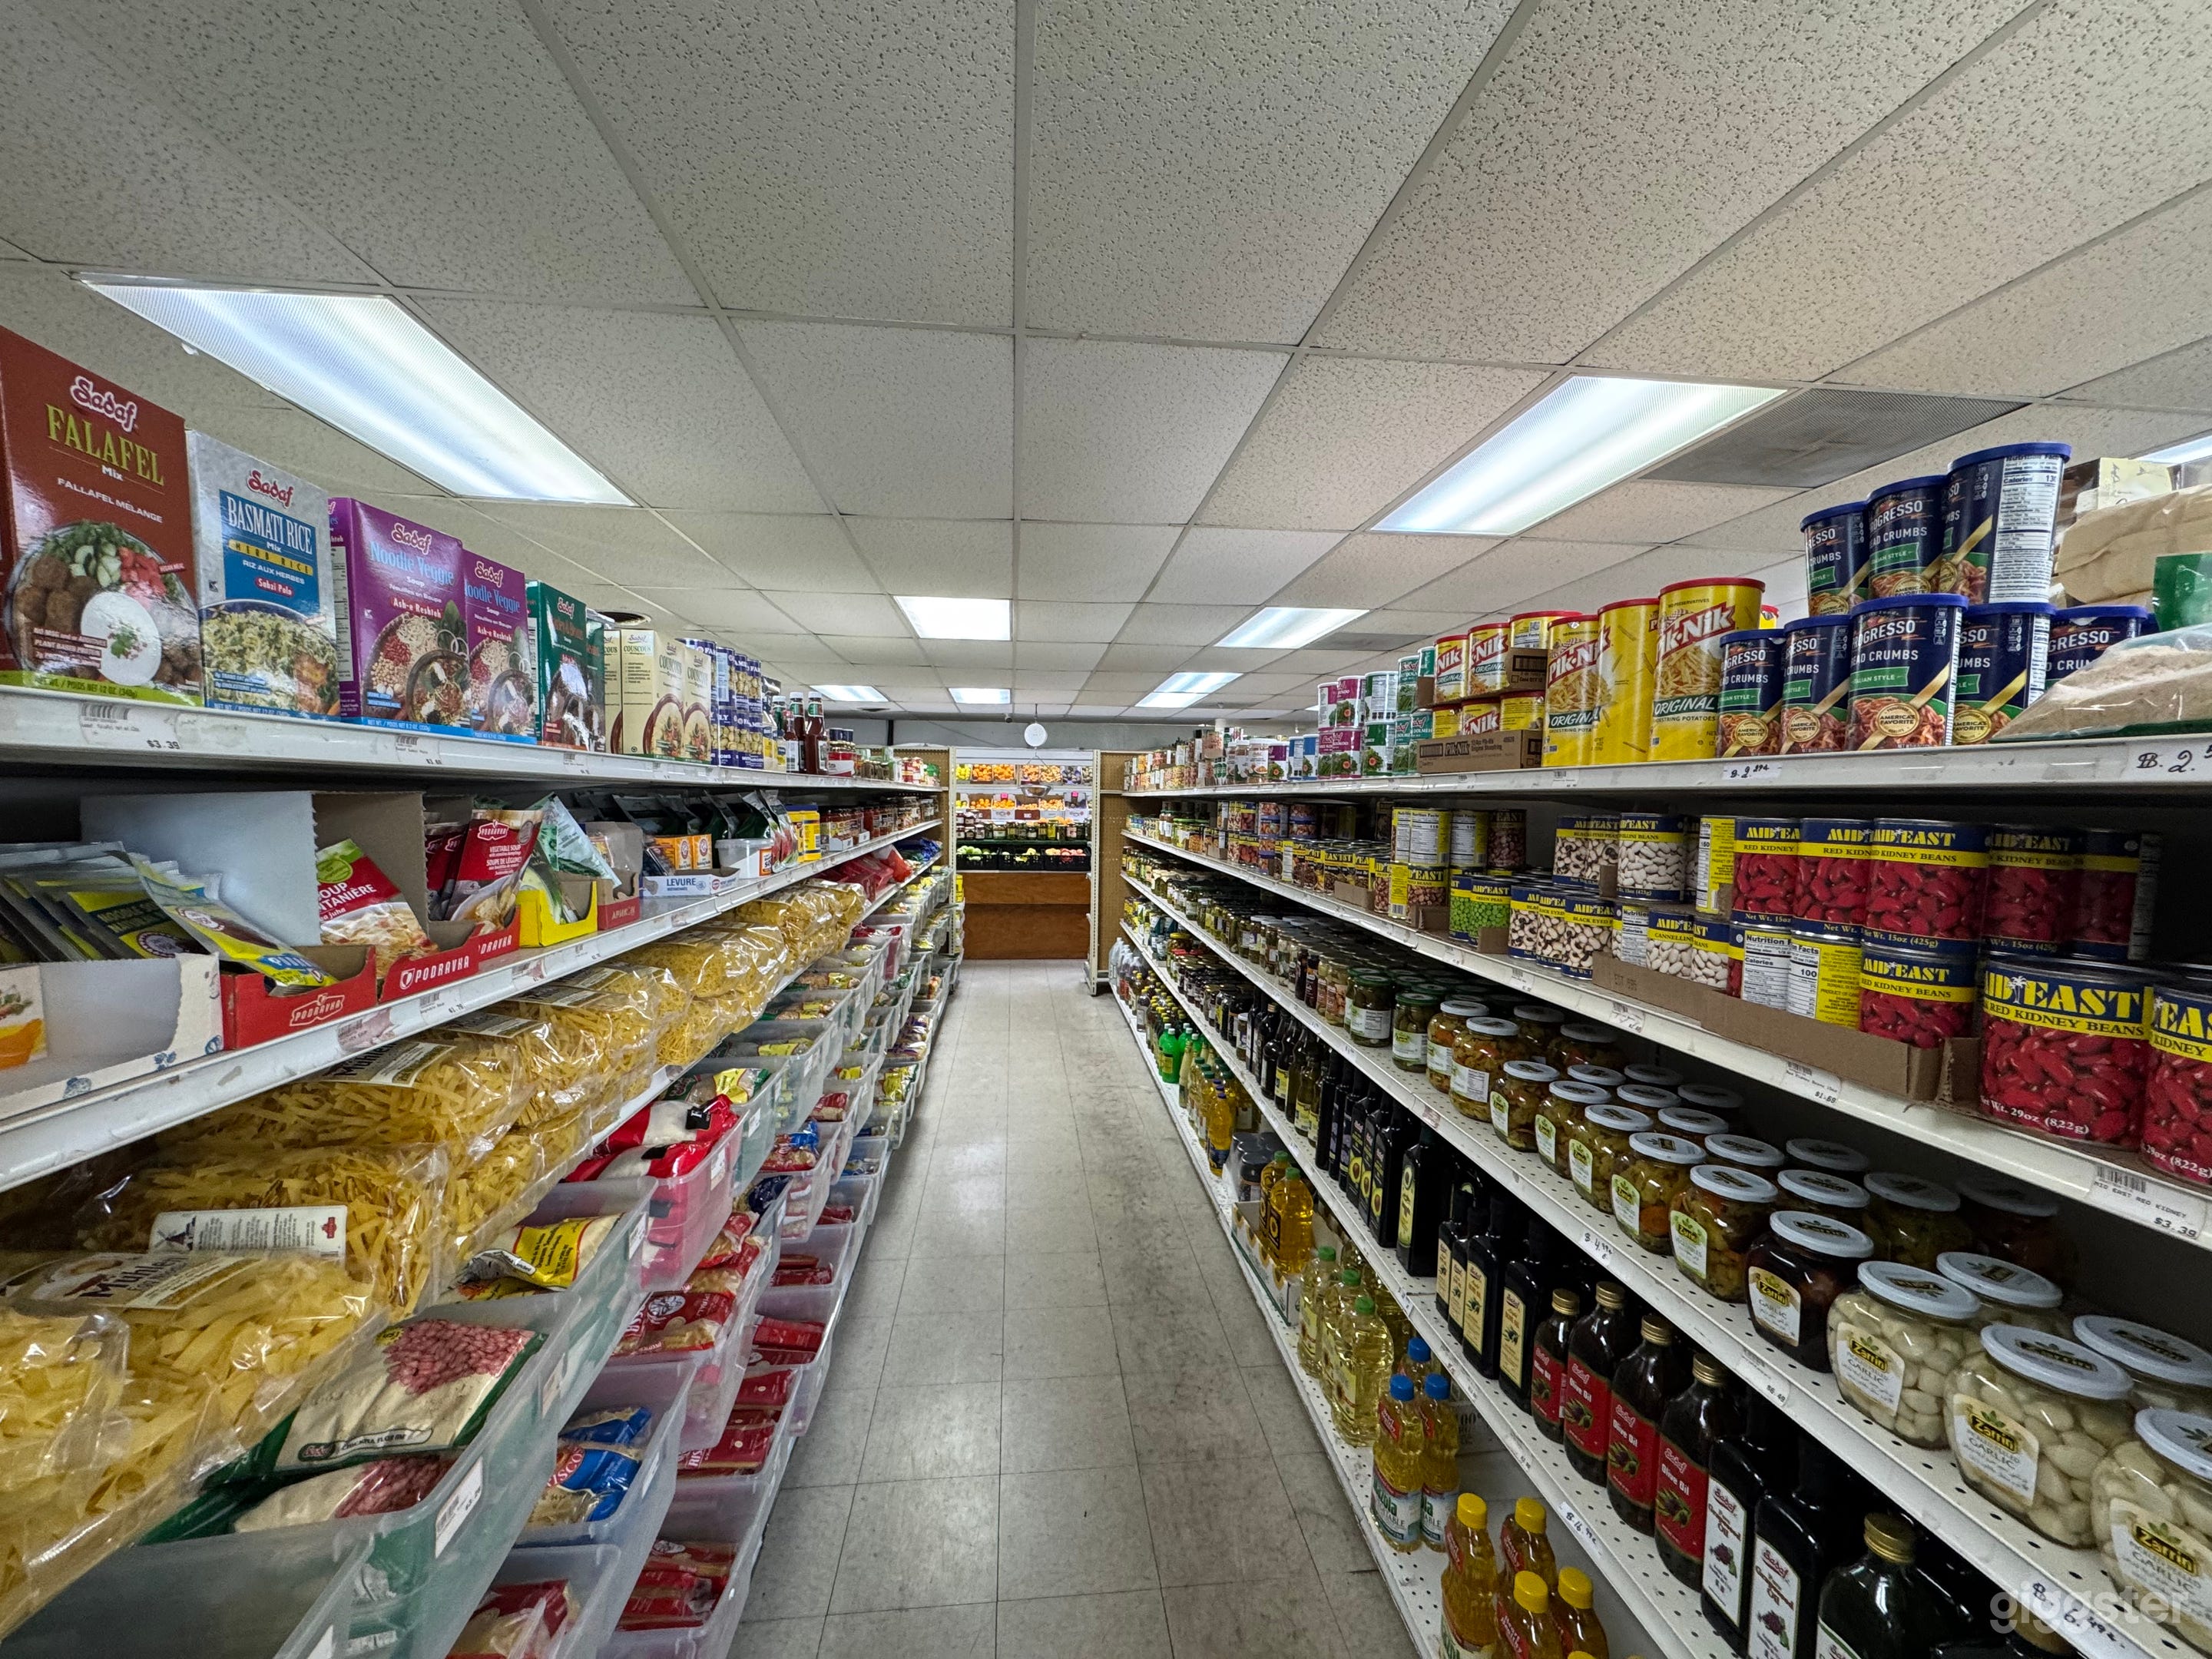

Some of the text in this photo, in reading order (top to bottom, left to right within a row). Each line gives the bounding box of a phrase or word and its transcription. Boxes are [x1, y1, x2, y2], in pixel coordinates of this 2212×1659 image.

[71, 376, 137, 432] Sadaf
[45, 404, 164, 486] FALAFEL
[101, 465, 124, 482] Mix
[58, 477, 114, 505] FALLAFEL
[247, 469, 295, 507] Sadaf
[227, 495, 285, 545] BASMATI
[286, 518, 313, 555] RICE
[1883, 526, 1928, 542] CRUMBS
[266, 541, 283, 554] Mix
[392, 523, 432, 555] Sadaf
[243, 560, 257, 570] RIZ
[257, 565, 275, 576] AUX
[369, 542, 455, 586] Noodle Veggie
[475, 561, 503, 588] Sadaf
[494, 589, 520, 614] Veggie
[1869, 649, 1919, 662] CRUMBS
[1730, 674, 1769, 684] CRUMBS
[1875, 673, 1896, 681] STYLE
[1654, 697, 1715, 715] ORIGINAL
[146, 739, 181, 750] $3.39
[1629, 820, 1659, 830] EAST
[1747, 826, 1774, 839] MID
[1826, 828, 1864, 843] MID
[1906, 831, 1955, 847] EAST
[1823, 847, 1843, 856] RED
[1881, 850, 1957, 863] KIDNEY BEANS
[1997, 854, 2041, 866] KIDNEY
[666, 878, 697, 886] LEVURE
[1485, 886, 1511, 896] EAST
[1575, 903, 1593, 915] MID
[1656, 919, 1678, 929] MID
[1758, 915, 1773, 923] Wt.
[1823, 923, 1858, 934] Net Wt.
[1747, 935, 1785, 945] Nutrition
[1873, 931, 1939, 948] Wt. 15oz (425g)
[2012, 939, 2033, 950] 15oz
[1798, 945, 1820, 955] Facts
[416, 955, 469, 983] PODRAVKA
[1745, 957, 1774, 966] Calories
[1863, 958, 1949, 982] MID EAST
[1800, 969, 1817, 978] 100
[1874, 980, 1912, 993] KIDNEY
[1916, 987, 1952, 998] BEANS
[294, 999, 341, 1022] PODRAVKA
[2028, 984, 2141, 1018] EAST
[1990, 1003, 2144, 1036] RED KIDNEY BEANS
[2154, 1036, 2207, 1057] KIDNEY
[1990, 1100, 2089, 1135] Wt. 29oz (822g)
[2112, 1187, 2132, 1199] EAST
[2135, 1195, 2151, 1207] RED
[2154, 1217, 2197, 1238] $3.39
[1851, 1339, 1886, 1372] Zarrin
[1847, 1359, 1885, 1386] GARLIC
[1615, 1404, 1636, 1428] Sadaf
[1613, 1419, 1638, 1448] Olive Oil
[1972, 1415, 2015, 1452] Zarrin
[1664, 1447, 1687, 1475] Sadaf
[1969, 1438, 2016, 1470] GARLIC
[1661, 1463, 1690, 1496] Olive Oil
[2136, 1526, 2195, 1574] Zarrin
[1763, 1549, 1790, 1580] Sadaf
[2132, 1551, 2196, 1595] GARLIC
